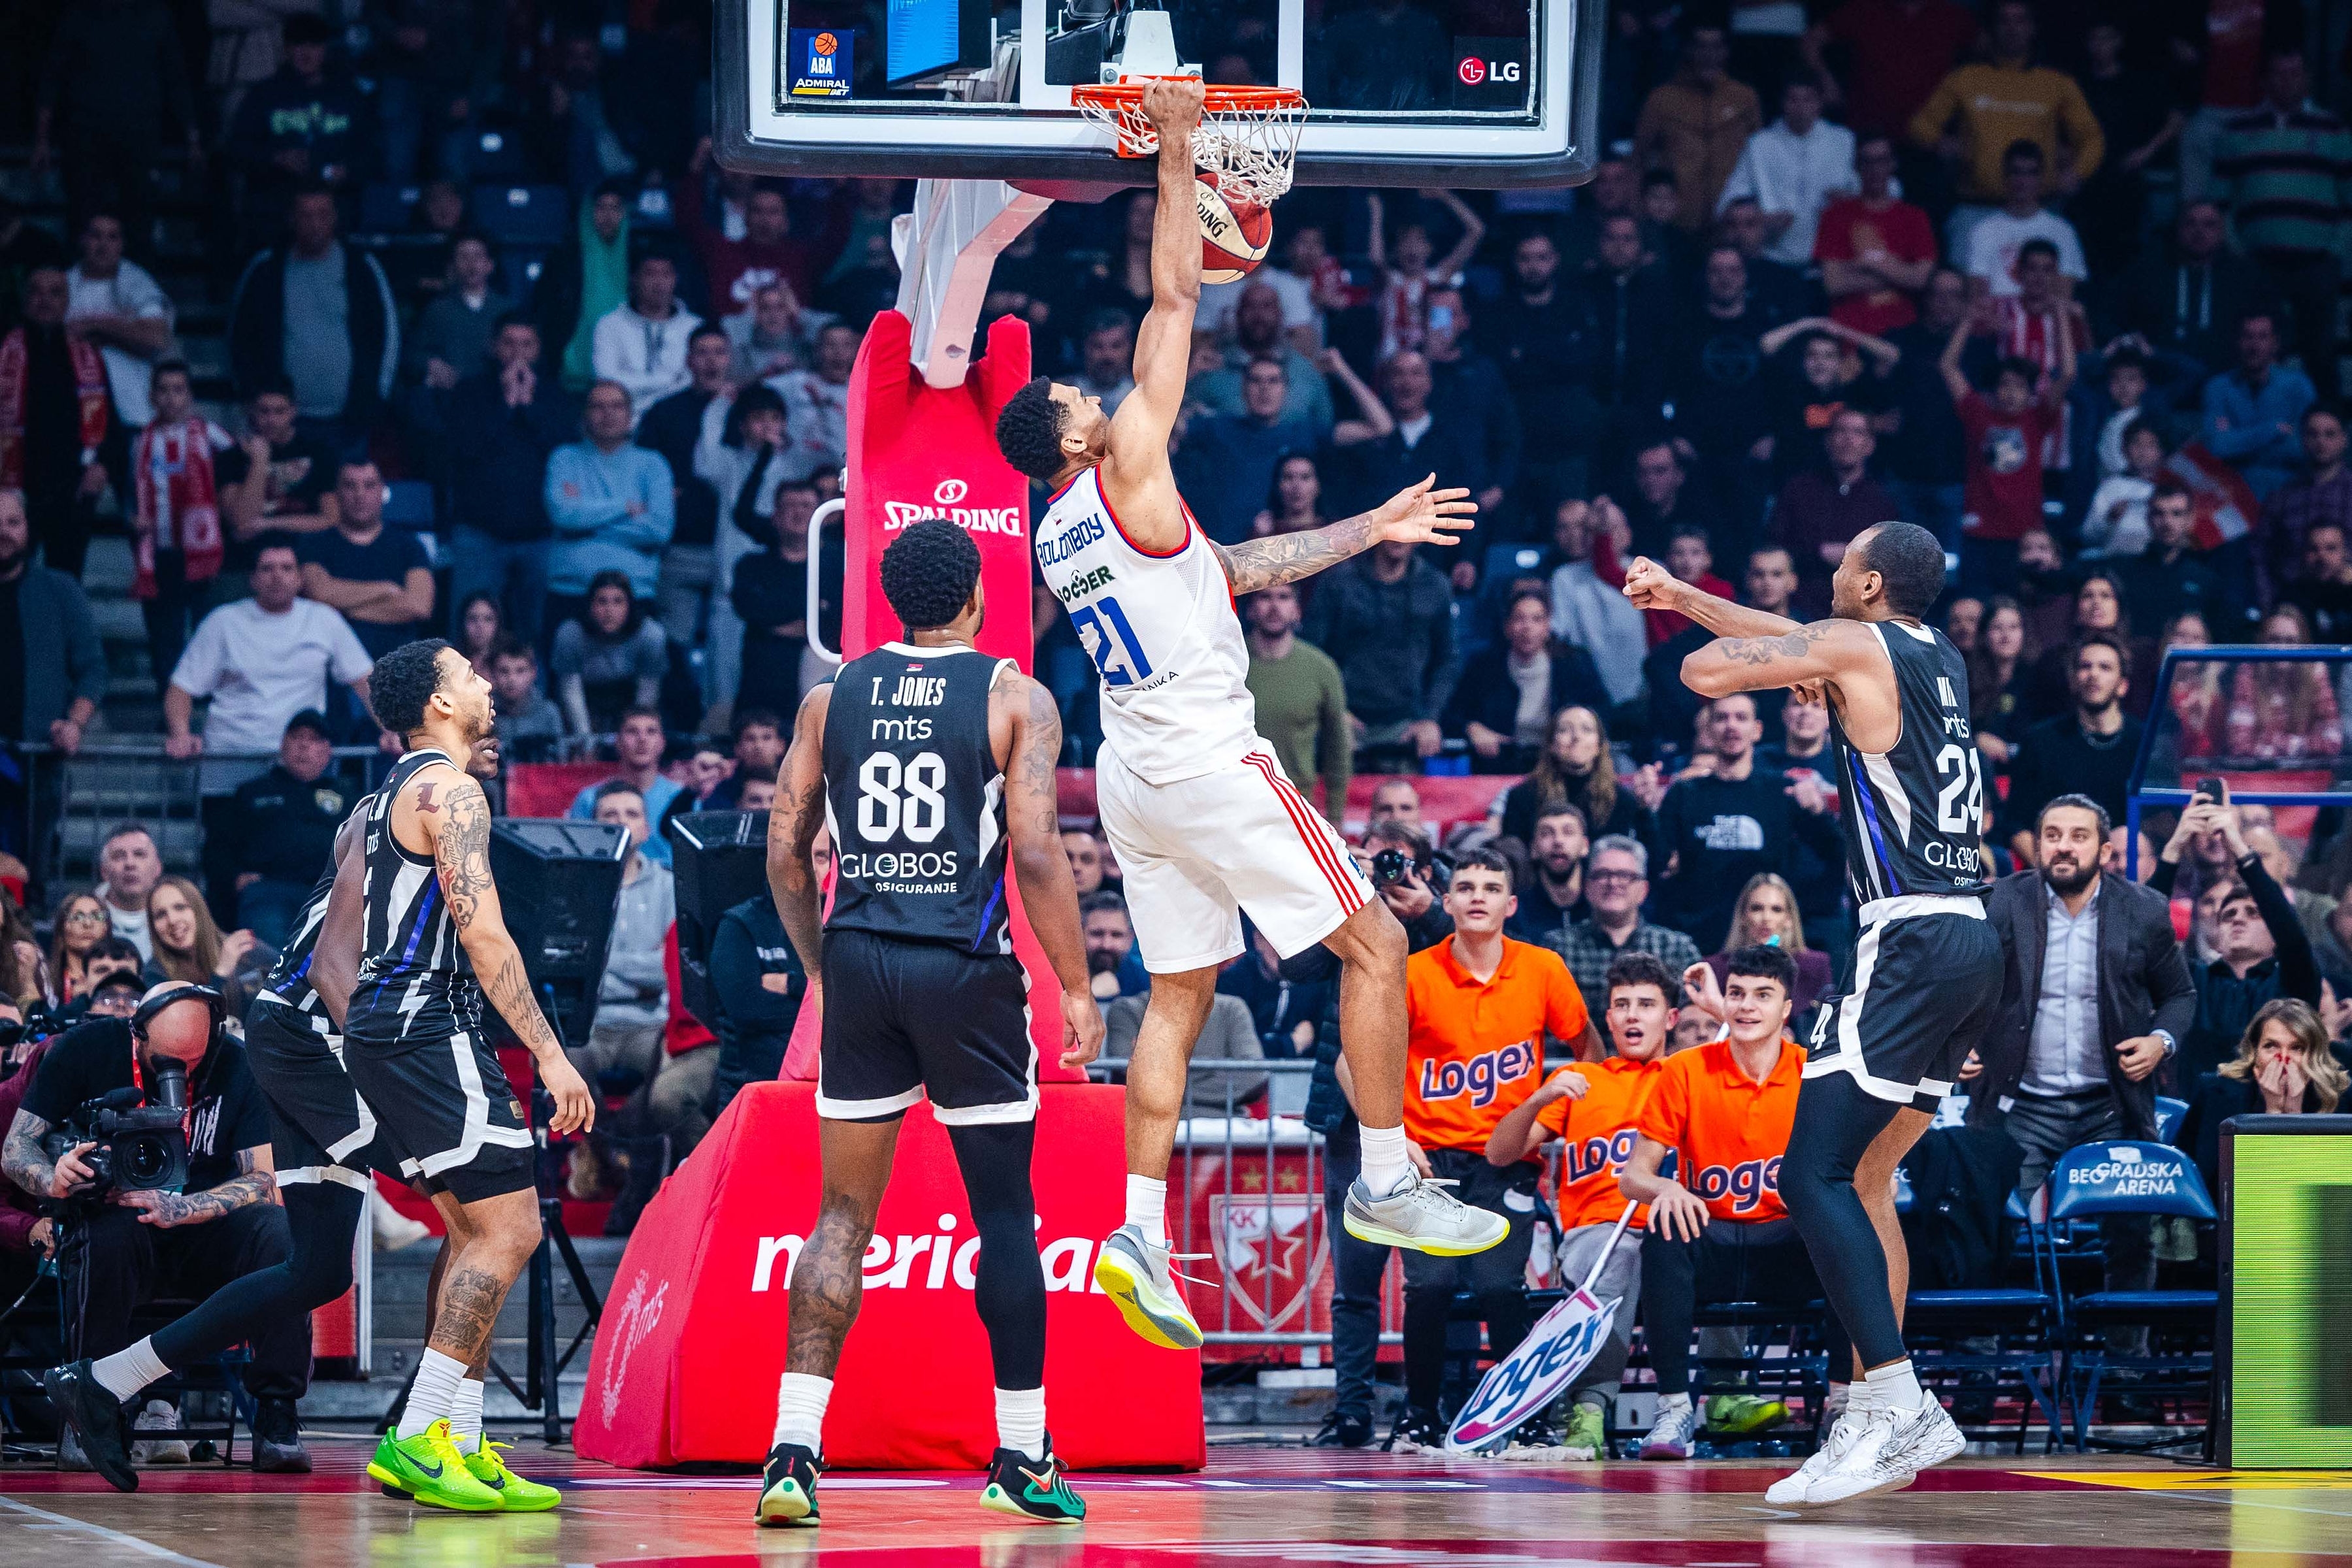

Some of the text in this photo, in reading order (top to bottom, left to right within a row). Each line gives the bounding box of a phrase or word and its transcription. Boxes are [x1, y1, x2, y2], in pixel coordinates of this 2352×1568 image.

[810, 57, 833, 74] ABA
[1490, 61, 1520, 82] LG
[795, 78, 849, 89] ADMIRAL
[1070, 596, 1153, 685] 21
[871, 676, 947, 706] T. JONES
[872, 715, 933, 741] mts
[857, 751, 946, 843] 88
[1936, 743, 1982, 836] 24
[841, 851, 958, 878] GLOBOS
[875, 882, 958, 894] OSIGURANJE
[1810, 1004, 1833, 1050] 4
[1420, 1040, 1535, 1109] Logex
[2068, 1162, 2183, 1184] BEOGRADSKA
[2114, 1179, 2176, 1195] ARENA
